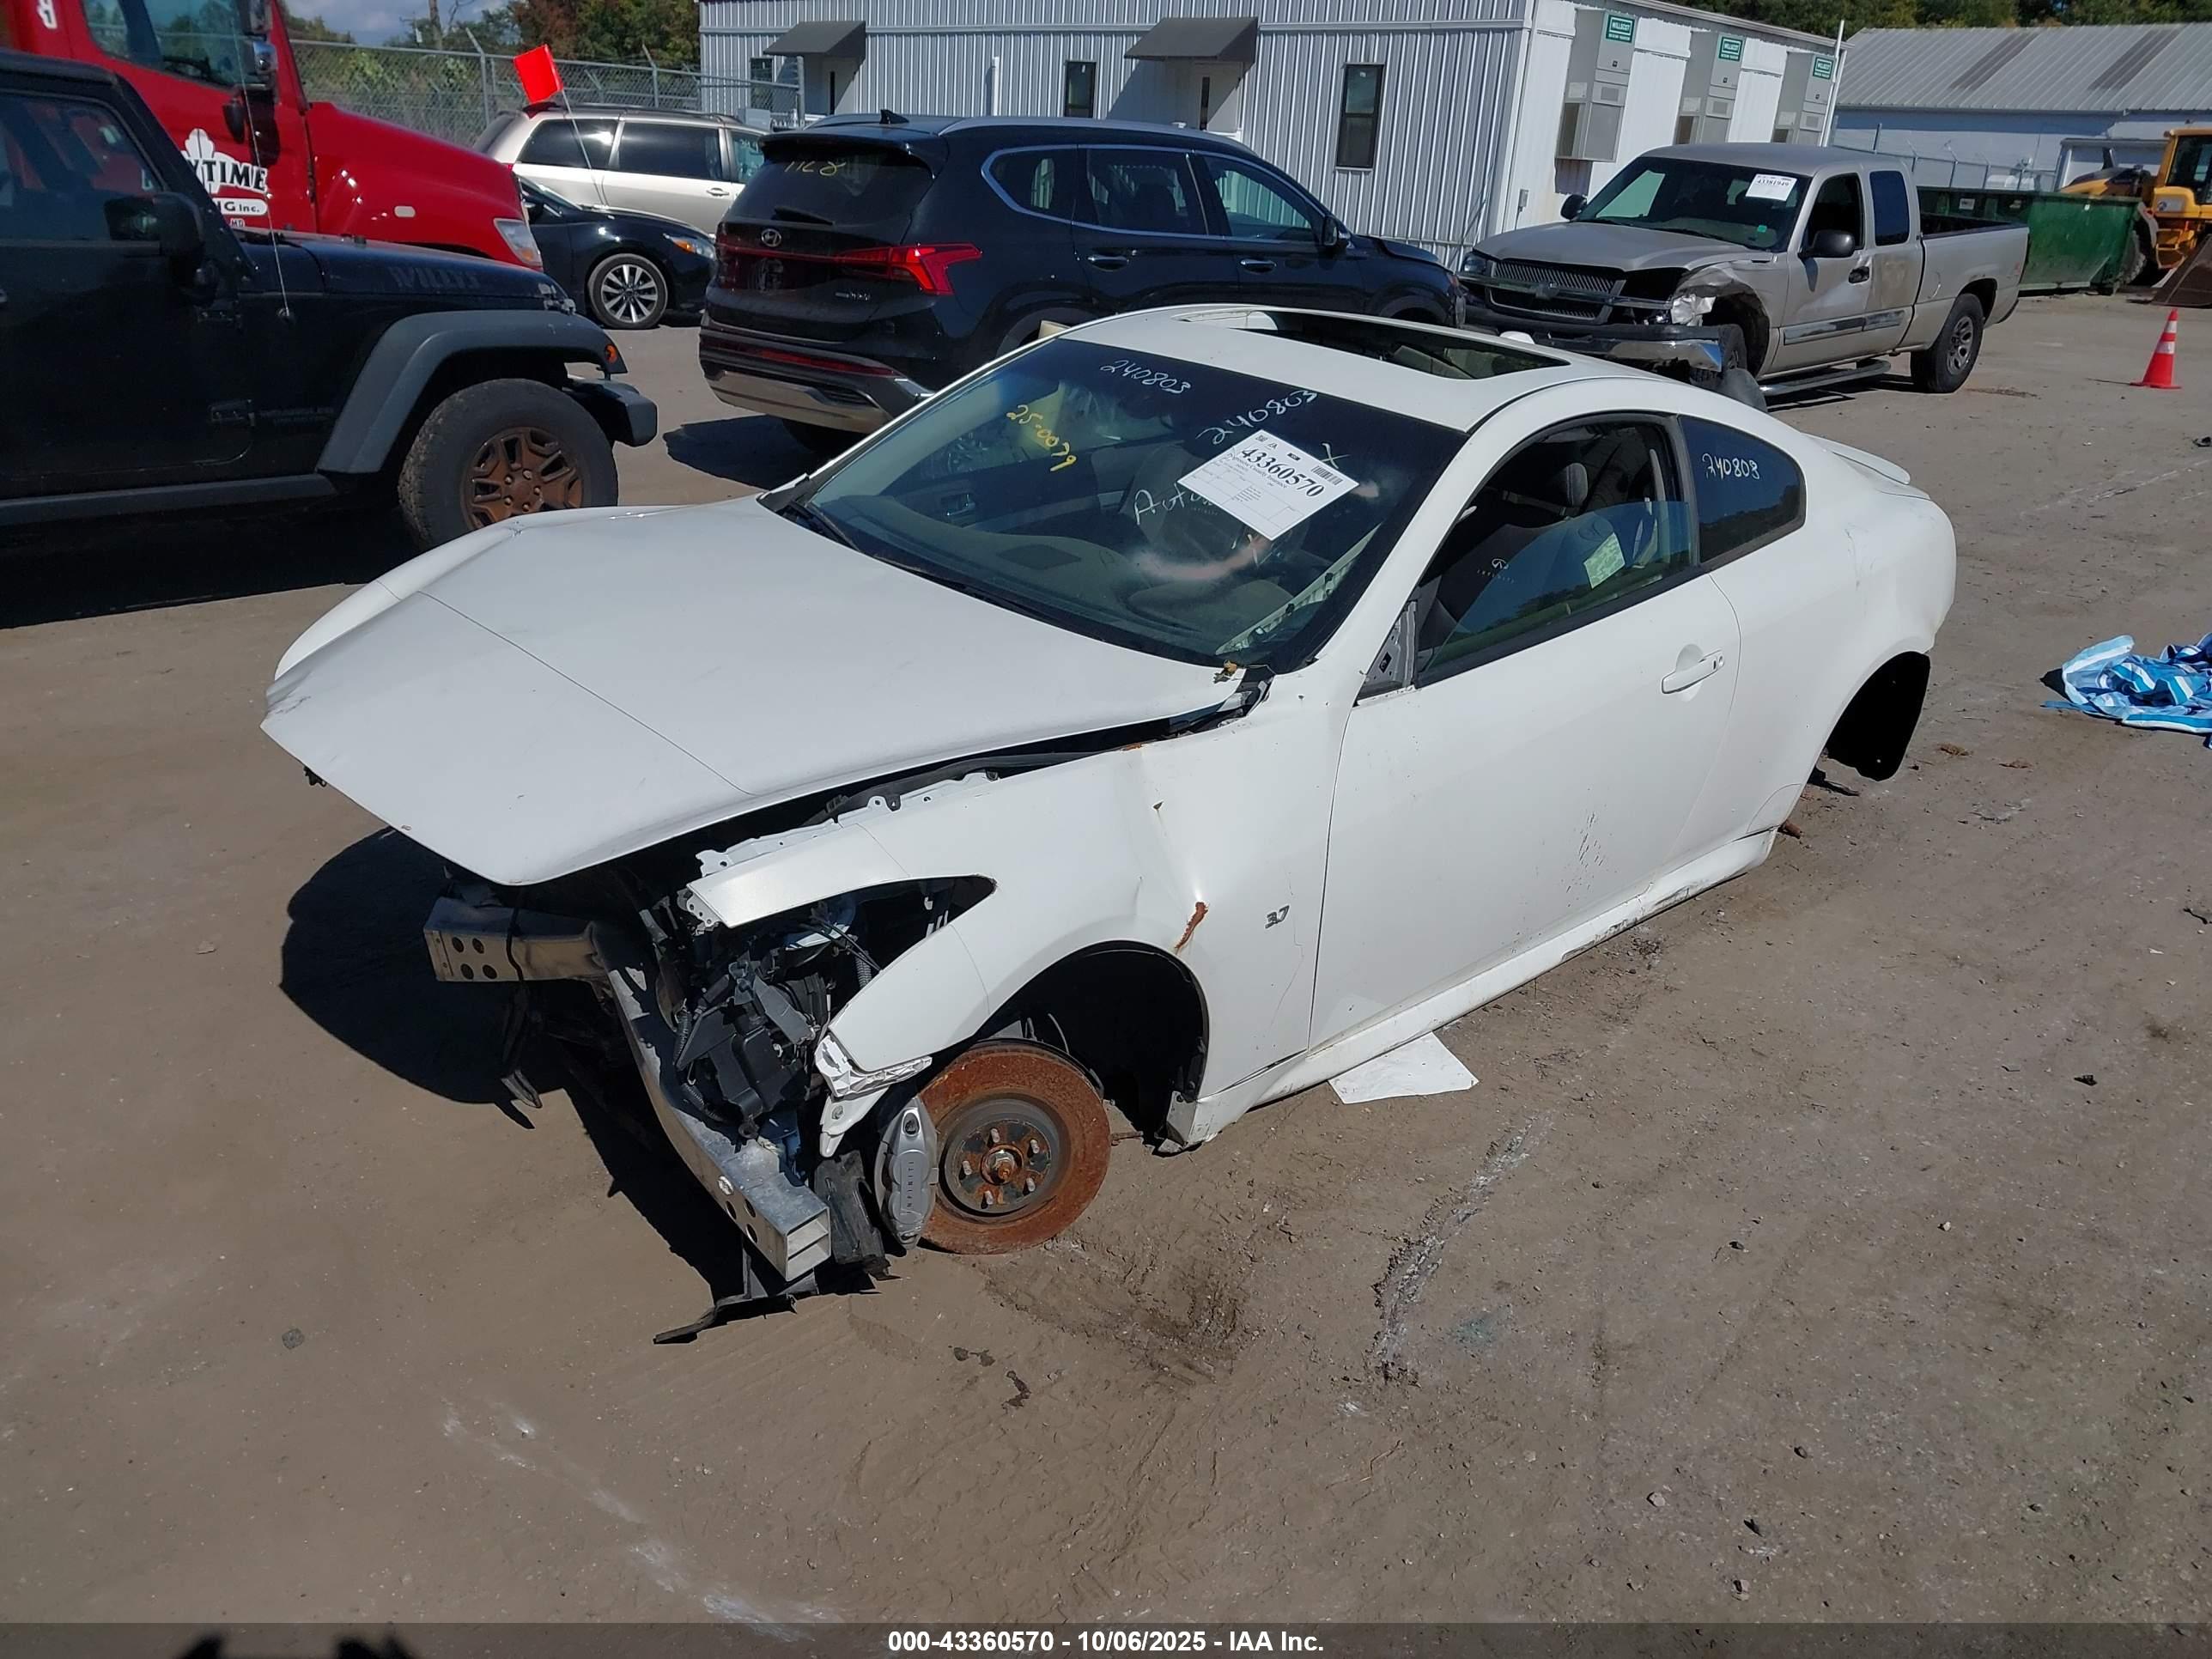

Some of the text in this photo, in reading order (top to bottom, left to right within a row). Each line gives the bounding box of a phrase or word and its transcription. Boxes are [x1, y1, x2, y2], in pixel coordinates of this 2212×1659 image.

[1100, 360, 1191, 394] 240803
[1195, 390, 1317, 445] 240803
[1241, 447, 1325, 497] 43360570
[906, 1162, 915, 1213] INFINITI
